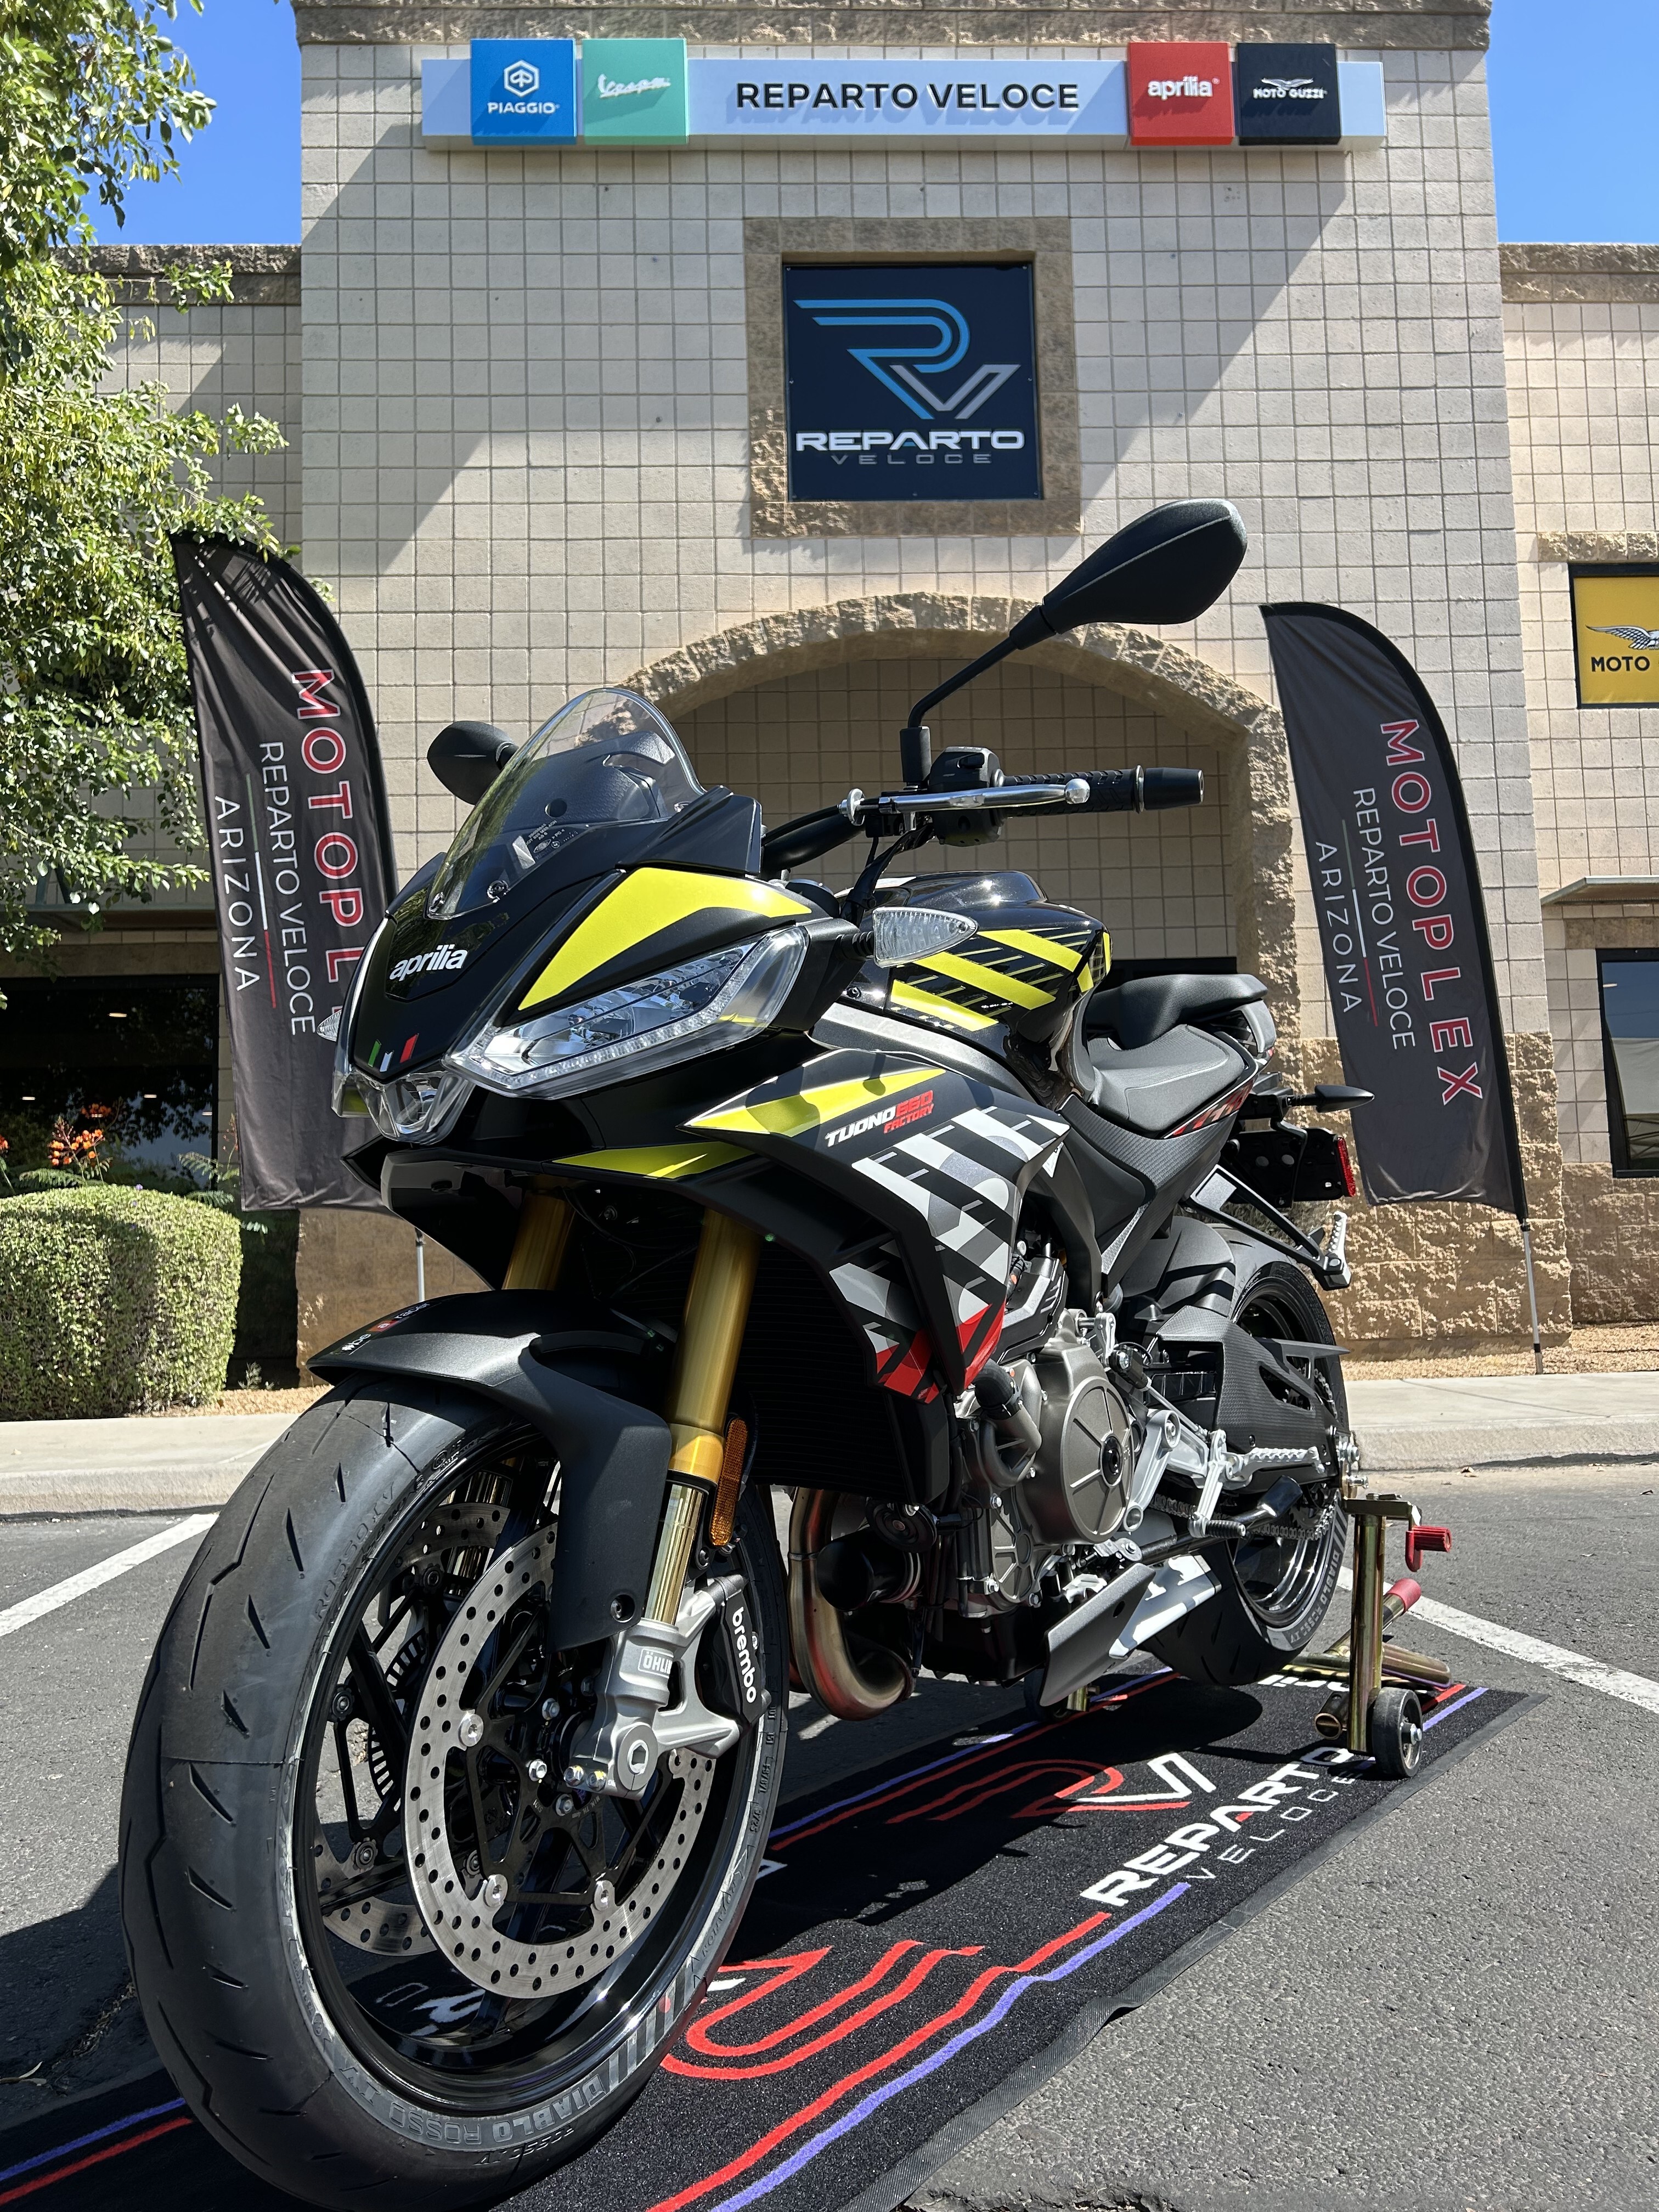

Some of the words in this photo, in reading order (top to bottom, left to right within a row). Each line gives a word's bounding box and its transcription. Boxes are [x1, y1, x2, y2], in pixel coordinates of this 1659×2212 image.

[487, 101, 556, 114] PIAGGIO
[597, 74, 671, 98] Vespa
[737, 82, 918, 109] REPARTO
[930, 83, 1080, 109] VELOCE
[1148, 75, 1214, 101] aprilia
[1253, 87, 1286, 99] MOTO
[1289, 87, 1324, 99] GUZZI
[795, 430, 1025, 452] REPARTO
[830, 453, 992, 465] VELOCE
[1591, 656, 1650, 673] MOTO
[291, 668, 364, 1015] MOTOPL
[215, 795, 261, 992] ARIZONA
[259, 741, 301, 895] REPARTO
[280, 902, 317, 1036] VELOCE
[1315, 841, 1362, 1013] ARIZONA
[1353, 787, 1394, 926] REPARTO
[1376, 930, 1416, 1050] VELOCE
[1380, 719, 1483, 1105] MOTOPLEX
[389, 944, 469, 981] aprilia
[883, 1103, 934, 1134] FACTORY
[1319, 1549, 1341, 1605] DIABLO
[732, 1606, 757, 1703] brembo
[1079, 1747, 1355, 1907] REPARTO
[1185, 1770, 1363, 1880] VELOCE
[337, 2067, 380, 2105] IV
[389, 2102, 482, 2145] ROSSO
[492, 2074, 606, 2143] DIABLO
